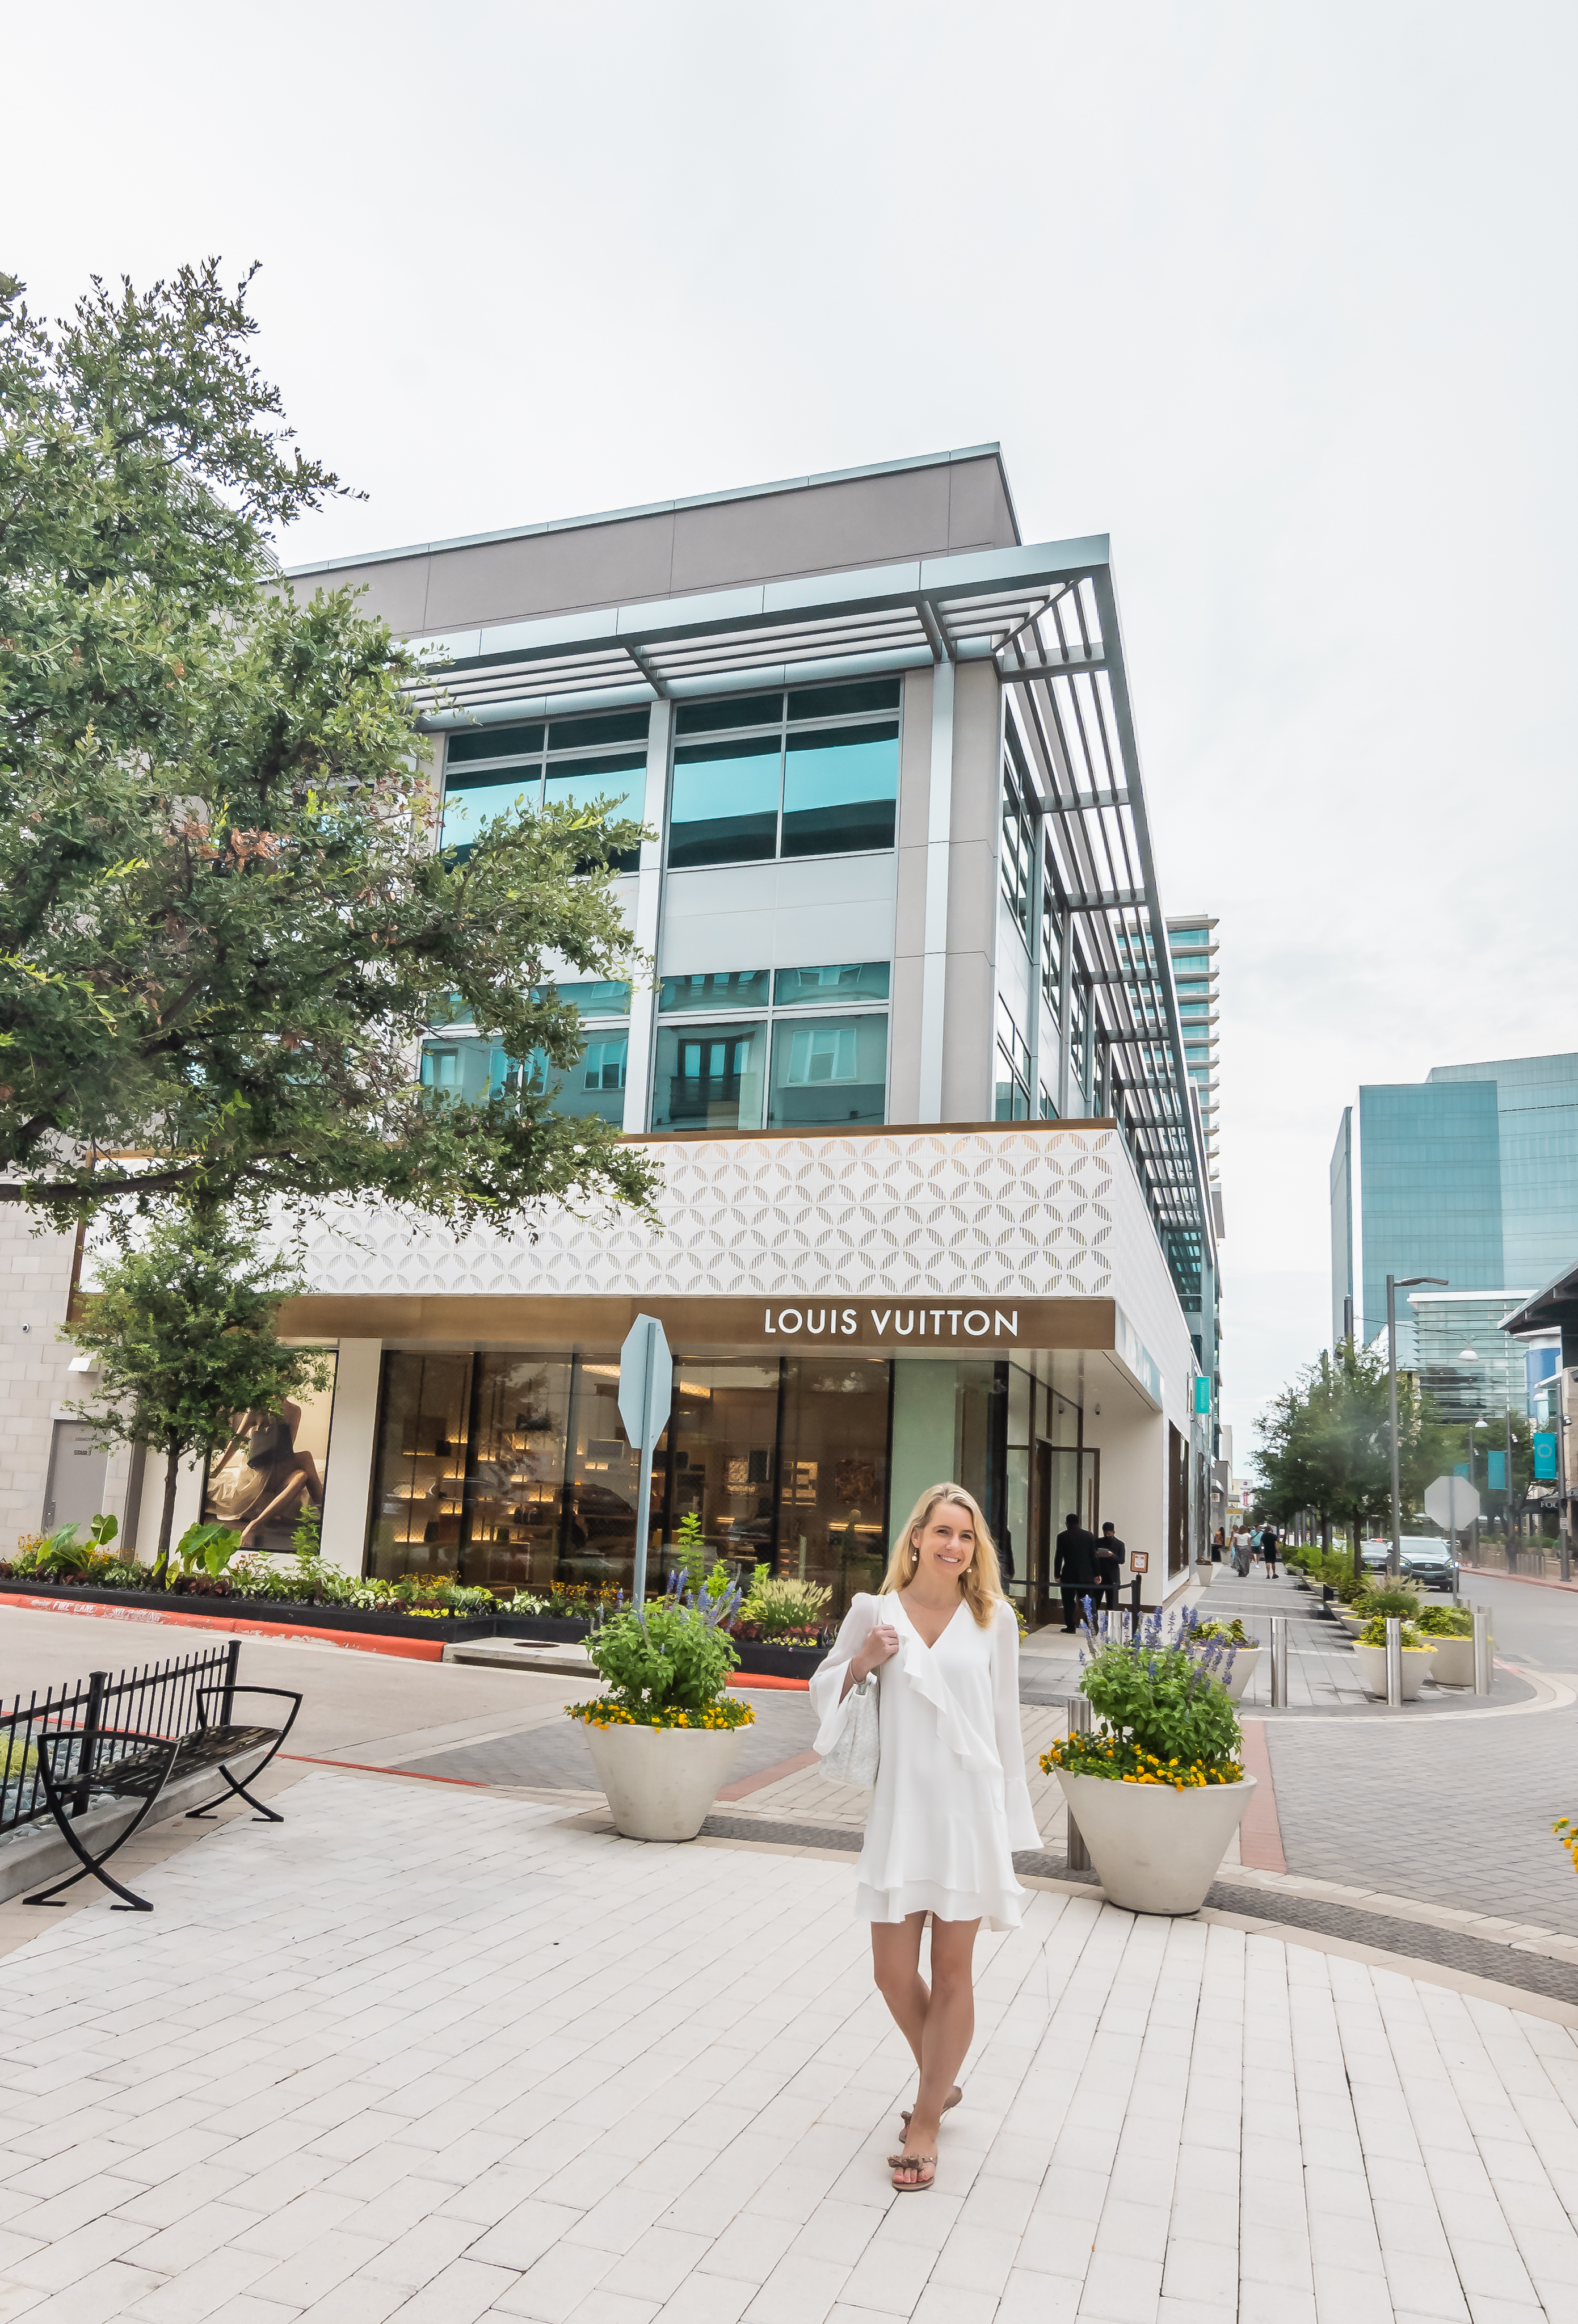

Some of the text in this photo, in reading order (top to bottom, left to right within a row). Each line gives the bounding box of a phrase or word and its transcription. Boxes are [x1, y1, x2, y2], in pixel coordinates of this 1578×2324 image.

[764, 1308, 1018, 1337] LOUIS VUITTON
[52, 1600, 74, 1611] FIRE
[74, 1603, 97, 1613] LANE
